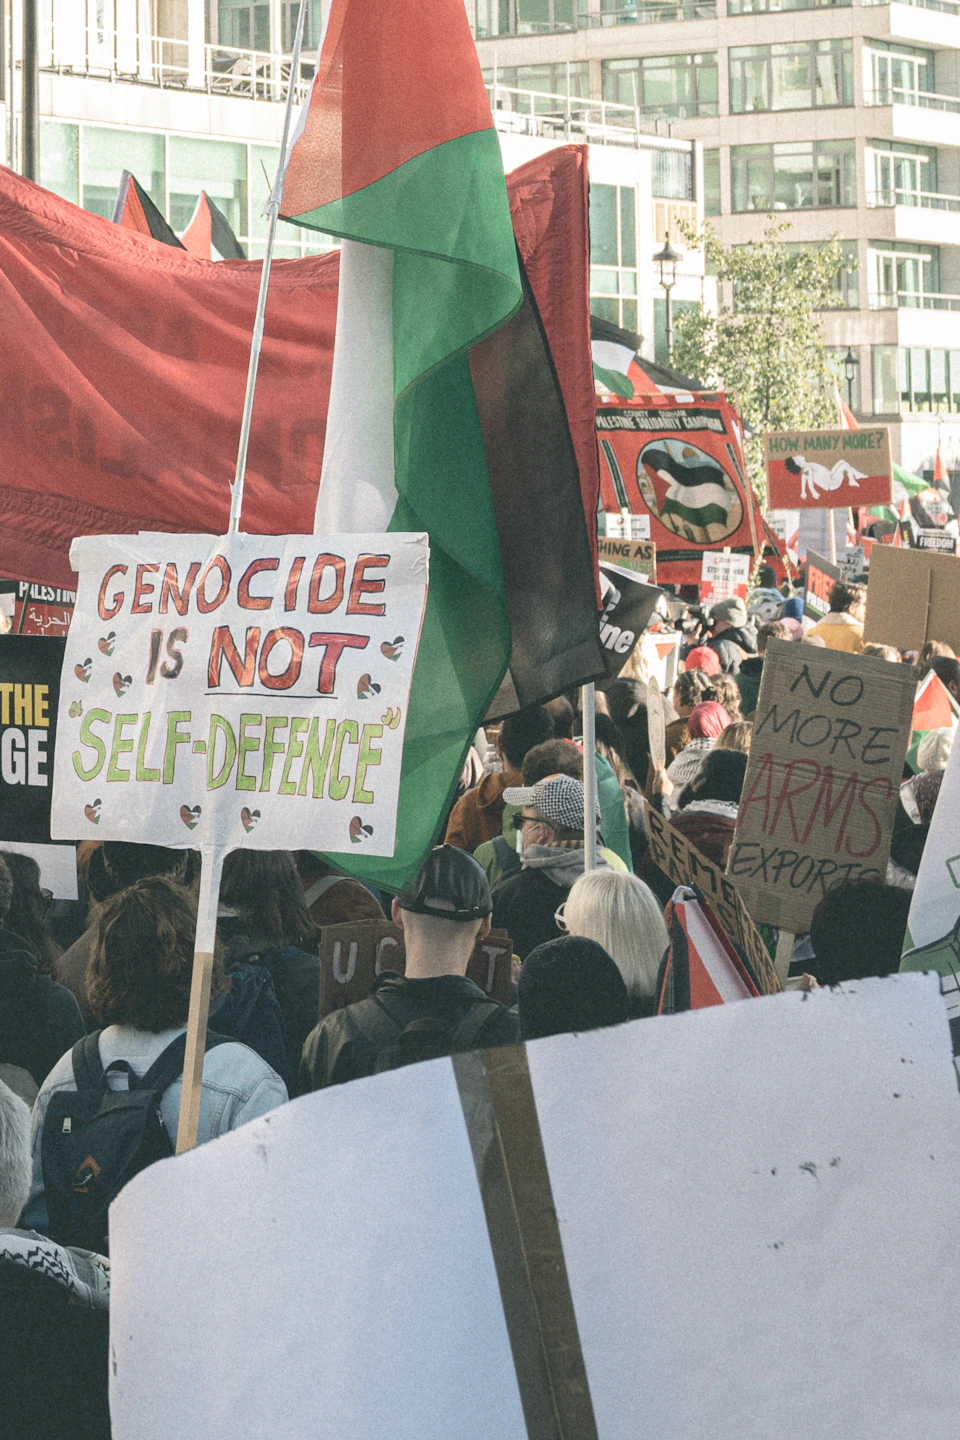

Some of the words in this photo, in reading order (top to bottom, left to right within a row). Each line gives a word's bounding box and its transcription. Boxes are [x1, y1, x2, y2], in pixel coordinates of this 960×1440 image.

[596, 416, 636, 430] PALESTINE
[636, 416, 682, 430] SOLIDARITY
[682, 415, 723, 432] CAMPAIGN
[769, 437, 799, 453] HOW
[803, 435, 841, 452] MANY
[842, 431, 885, 451] MORE?
[633, 545, 653, 560] AS
[919, 536, 954, 549] FREEDOM
[97, 553, 391, 621] GENOCIDE
[145, 626, 189, 686] IS
[207, 625, 371, 694] NOT
[790, 664, 864, 707] NO
[755, 704, 900, 765] MORE
[737, 752, 894, 858] ARMS
